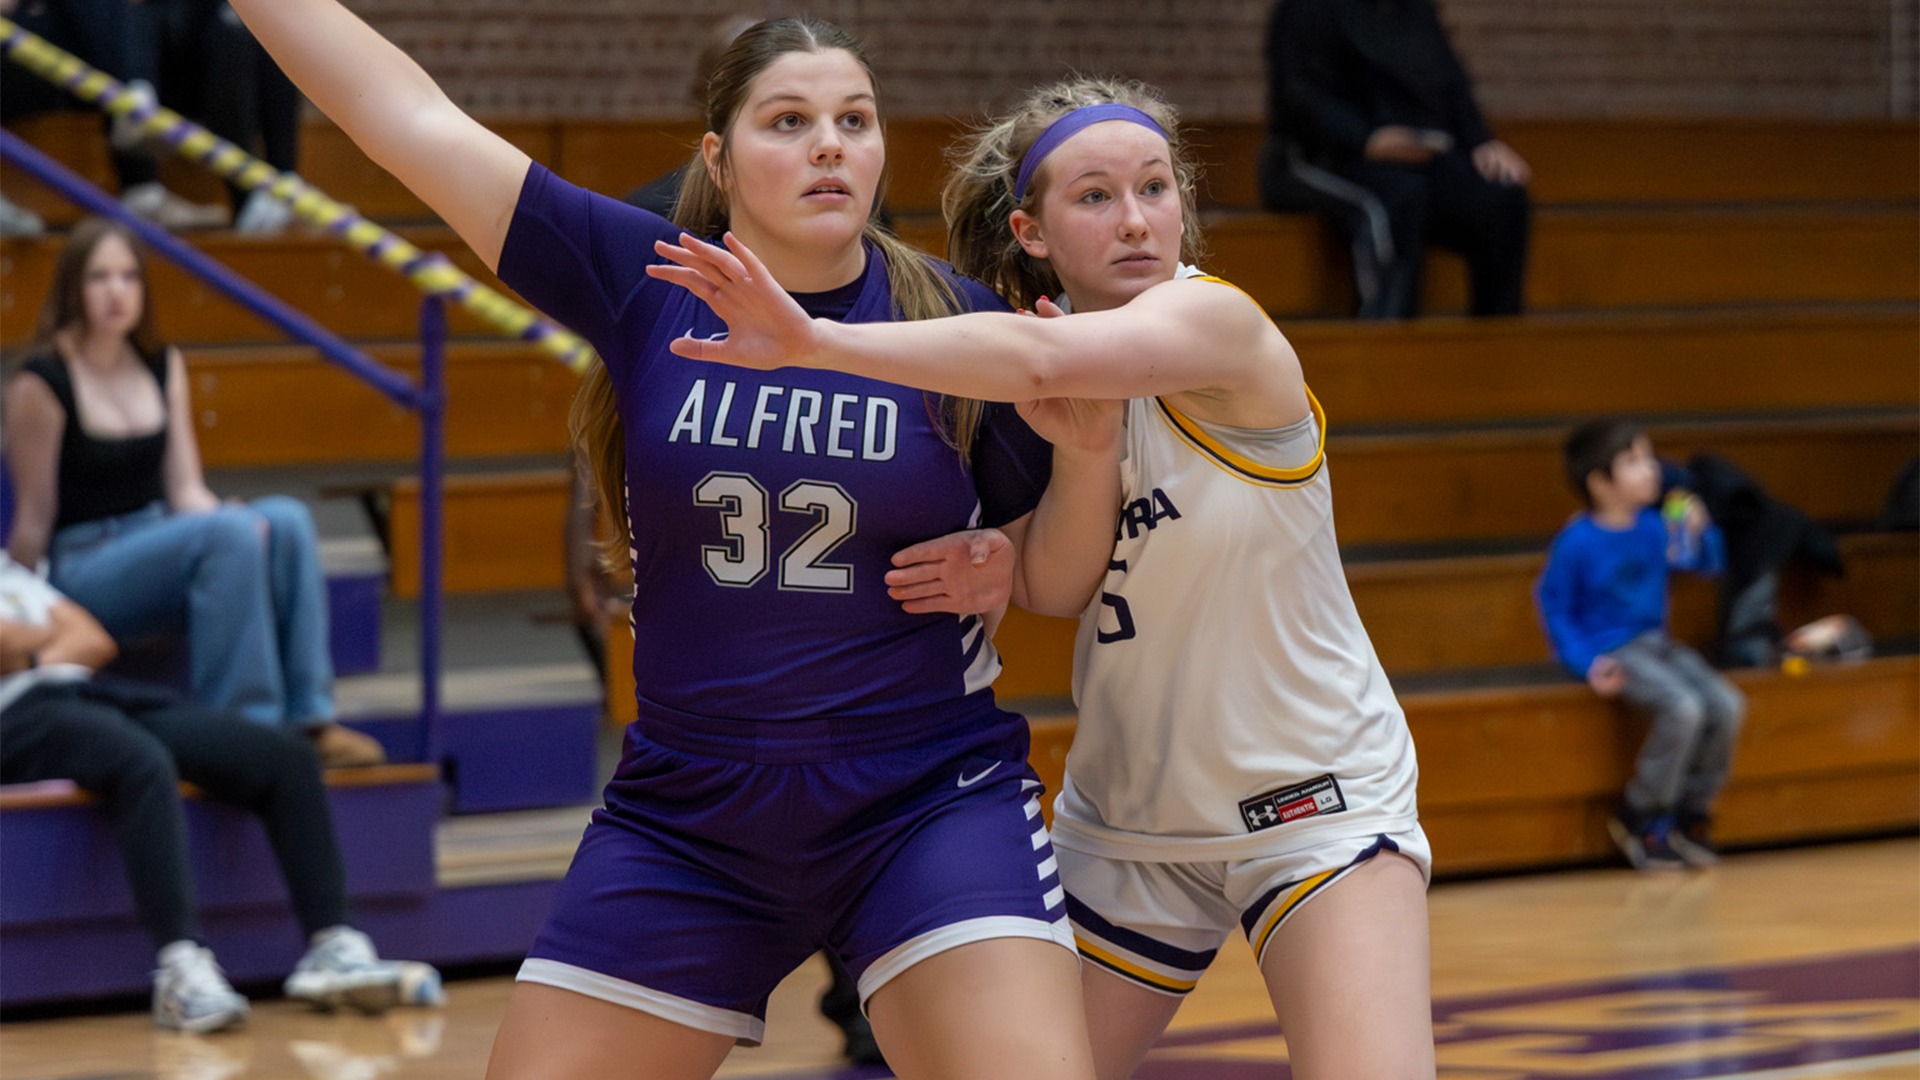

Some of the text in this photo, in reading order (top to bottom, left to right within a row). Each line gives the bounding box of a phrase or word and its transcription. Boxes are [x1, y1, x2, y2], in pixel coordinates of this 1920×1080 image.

[667, 379, 899, 462] ALFRED
[692, 470, 858, 594] 32
[1281, 802, 1316, 820] AUTHENTIC
[1320, 796, 1333, 805] LG
